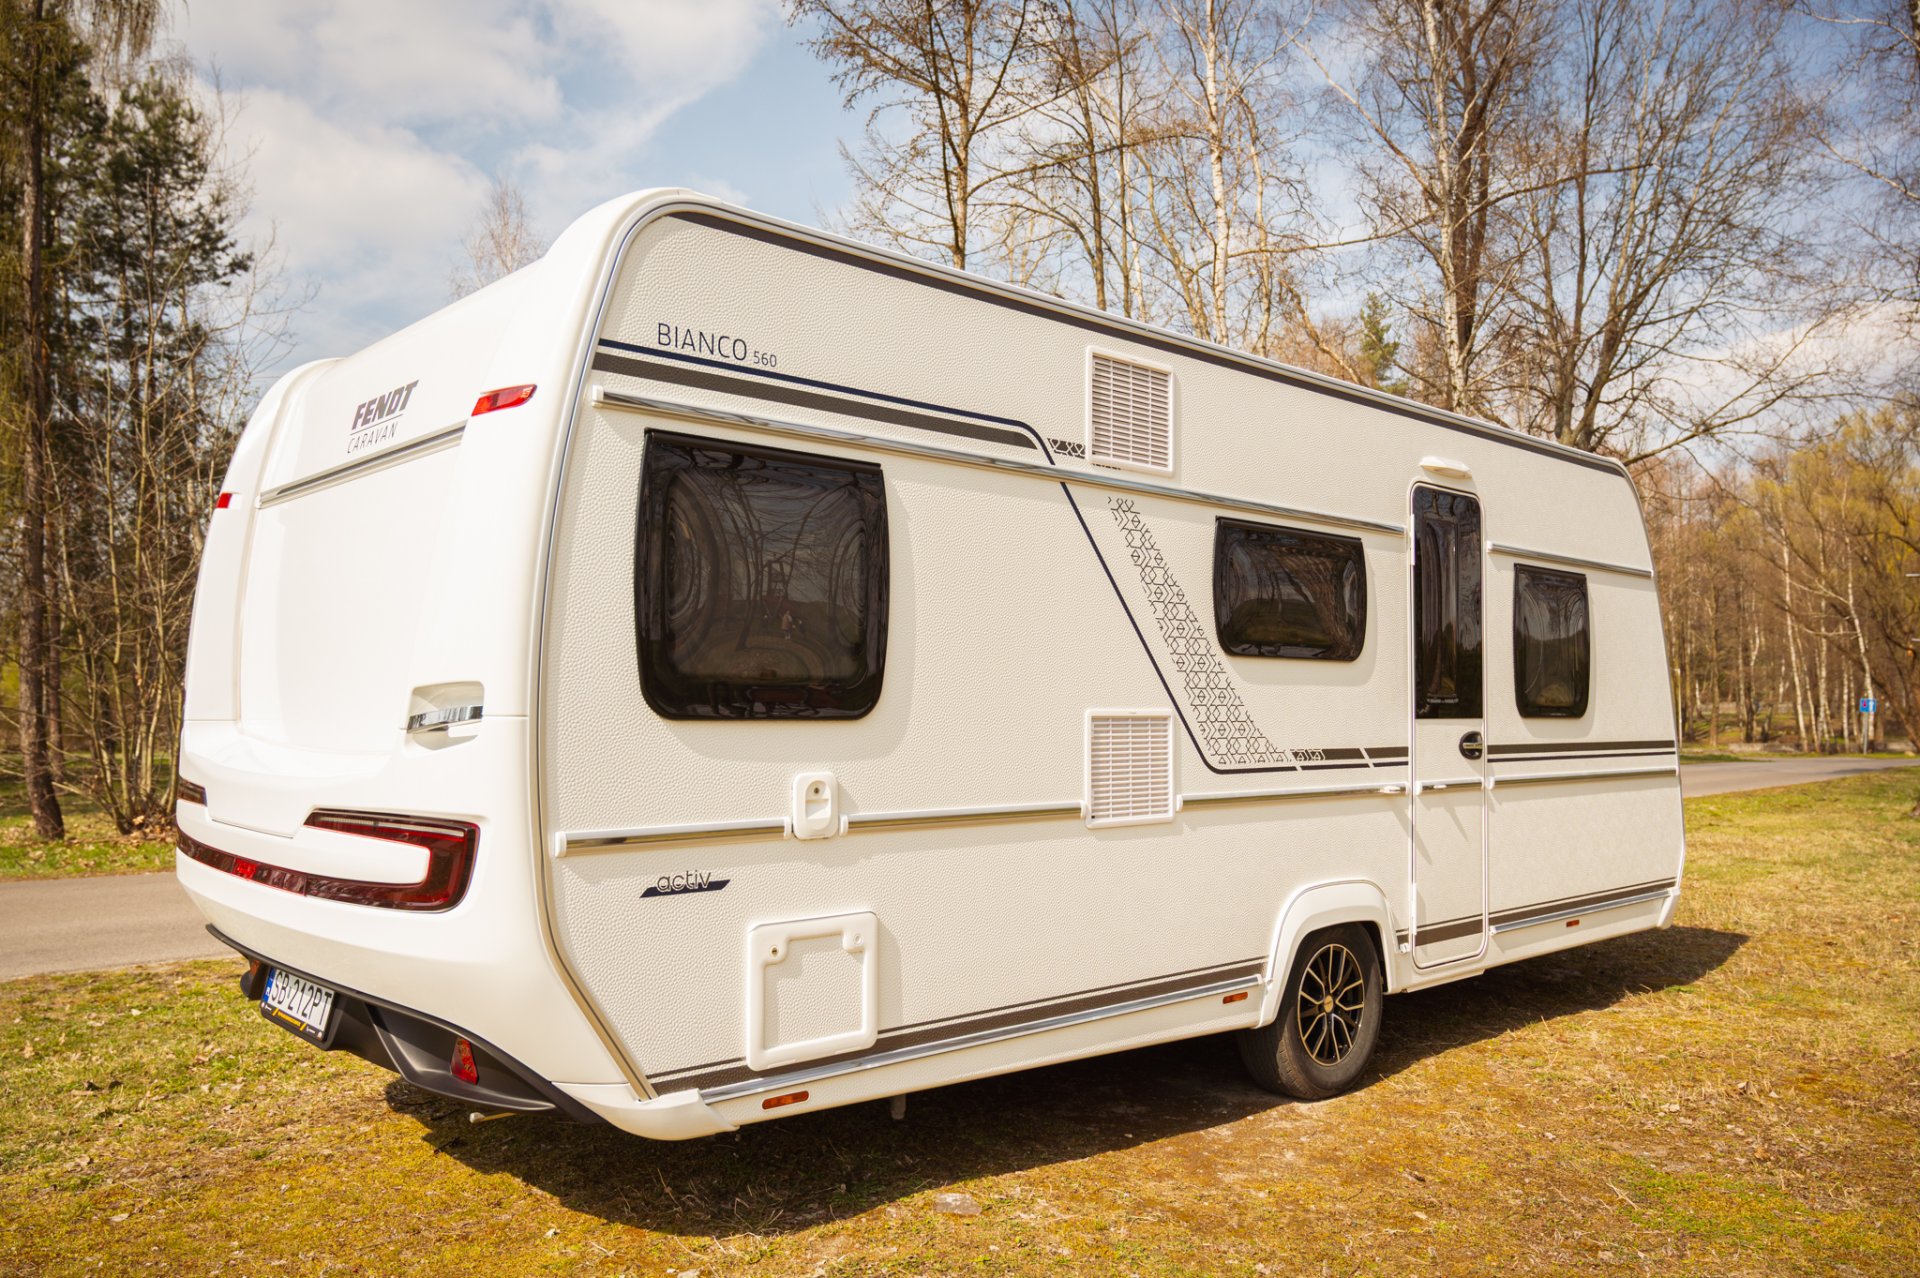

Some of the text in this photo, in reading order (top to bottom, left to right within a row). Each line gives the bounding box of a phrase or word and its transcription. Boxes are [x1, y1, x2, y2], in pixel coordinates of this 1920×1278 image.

[658, 322, 777, 368] BIANCO 560
[351, 379, 420, 431] FENDT
[346, 421, 399, 454] CARAVAN
[656, 869, 711, 892] activ
[271, 971, 290, 1005] SB
[287, 979, 333, 1026] 212PT
